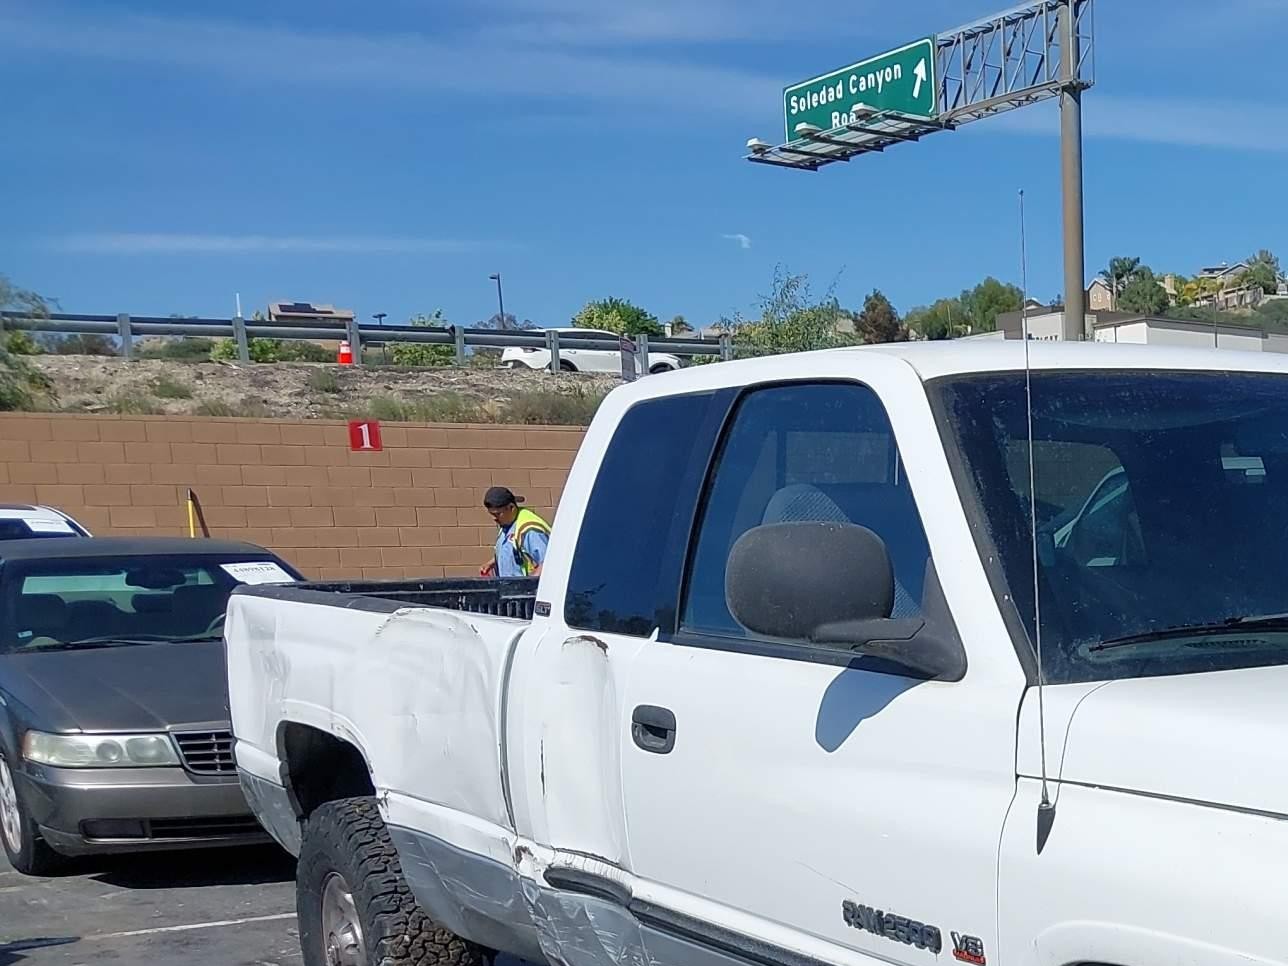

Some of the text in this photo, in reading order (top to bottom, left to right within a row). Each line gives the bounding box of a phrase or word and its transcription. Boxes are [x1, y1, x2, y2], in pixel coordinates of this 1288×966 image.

[790, 64, 902, 115] Soledad Canyon
[831, 111, 858, 129] Roa
[357, 423, 374, 449] 1
